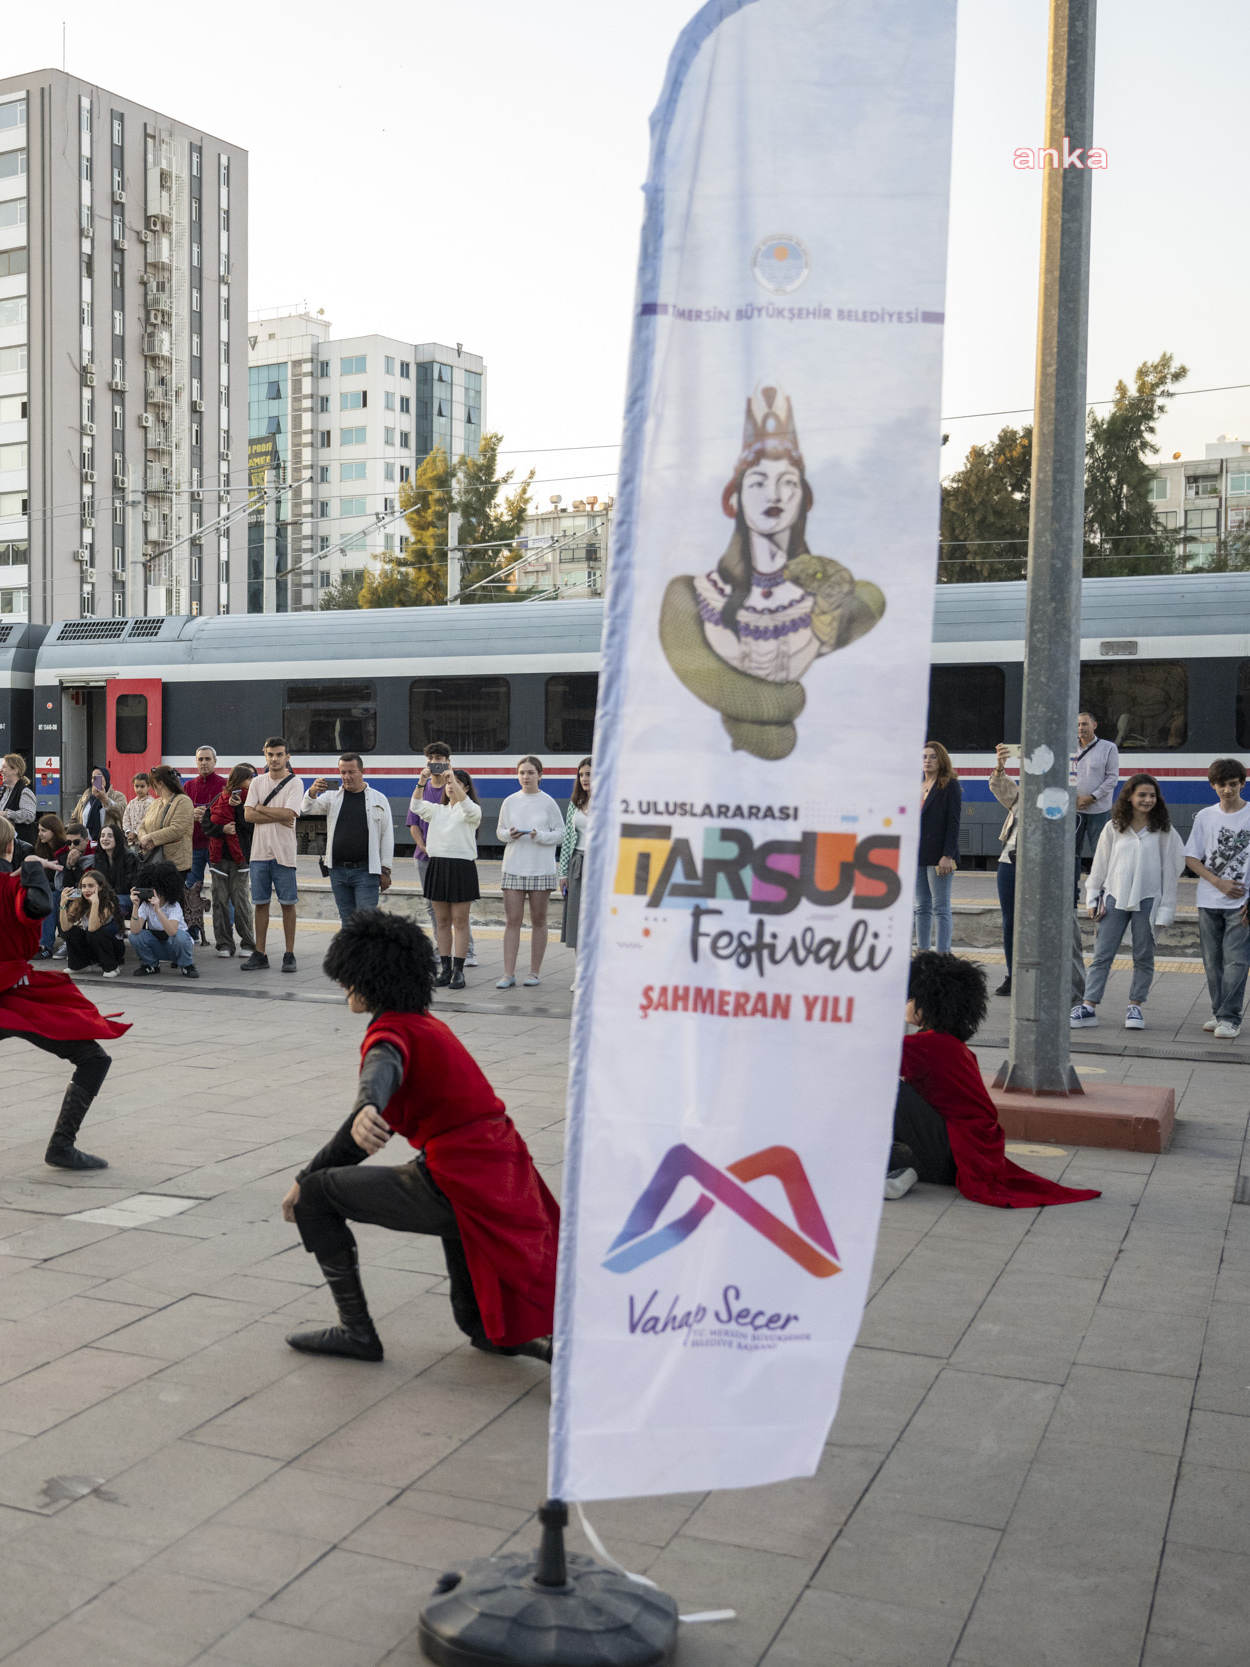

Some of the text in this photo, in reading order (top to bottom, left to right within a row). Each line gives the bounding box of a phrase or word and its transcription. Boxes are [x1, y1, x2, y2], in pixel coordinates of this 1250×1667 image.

[736, 302, 832, 320] BÜYÜKŞEHİR
[837, 307, 920, 324] BELEDİYESİ
[46, 758, 53, 768] 4
[620, 799, 800, 821] 2. ULUSLARARASI
[616, 823, 902, 916] TARSUS
[691, 904, 893, 978] Festivali
[639, 985, 855, 1023] ŞAHMERAN YILI
[629, 1289, 707, 1347] Vahap
